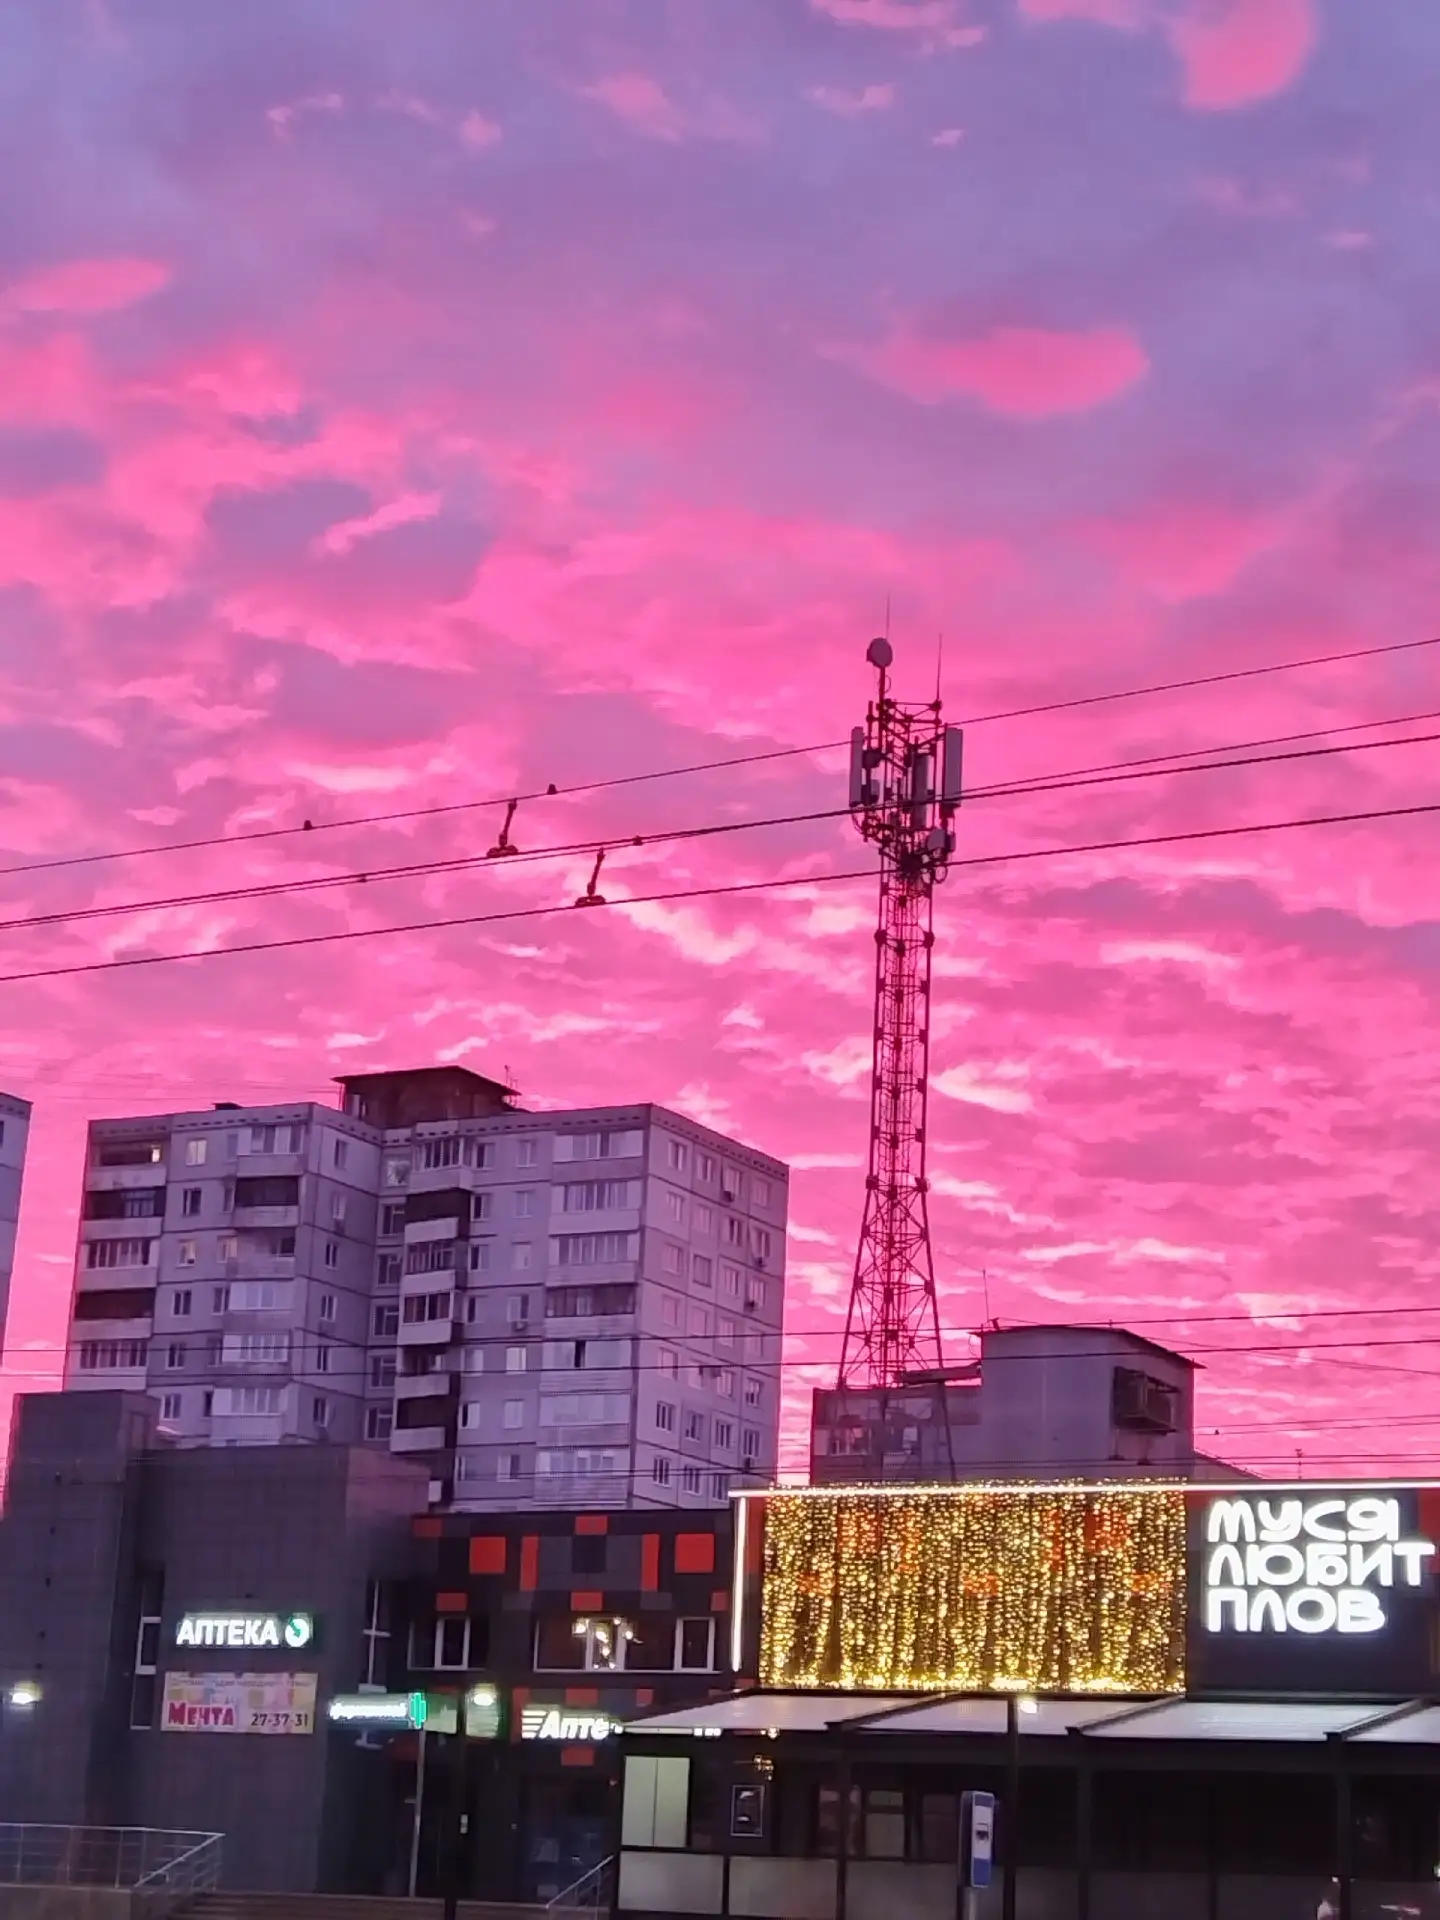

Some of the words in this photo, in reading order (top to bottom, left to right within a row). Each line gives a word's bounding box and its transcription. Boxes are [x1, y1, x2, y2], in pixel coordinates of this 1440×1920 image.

[1207, 1498, 1399, 1542] МУСЯ
[1208, 1543, 1436, 1586] ЛЮБИТ
[1207, 1588, 1386, 1633] ПЛОВ
[176, 1619, 280, 1646] АПТЕКА
[250, 1713, 309, 1727] 27-37-31
